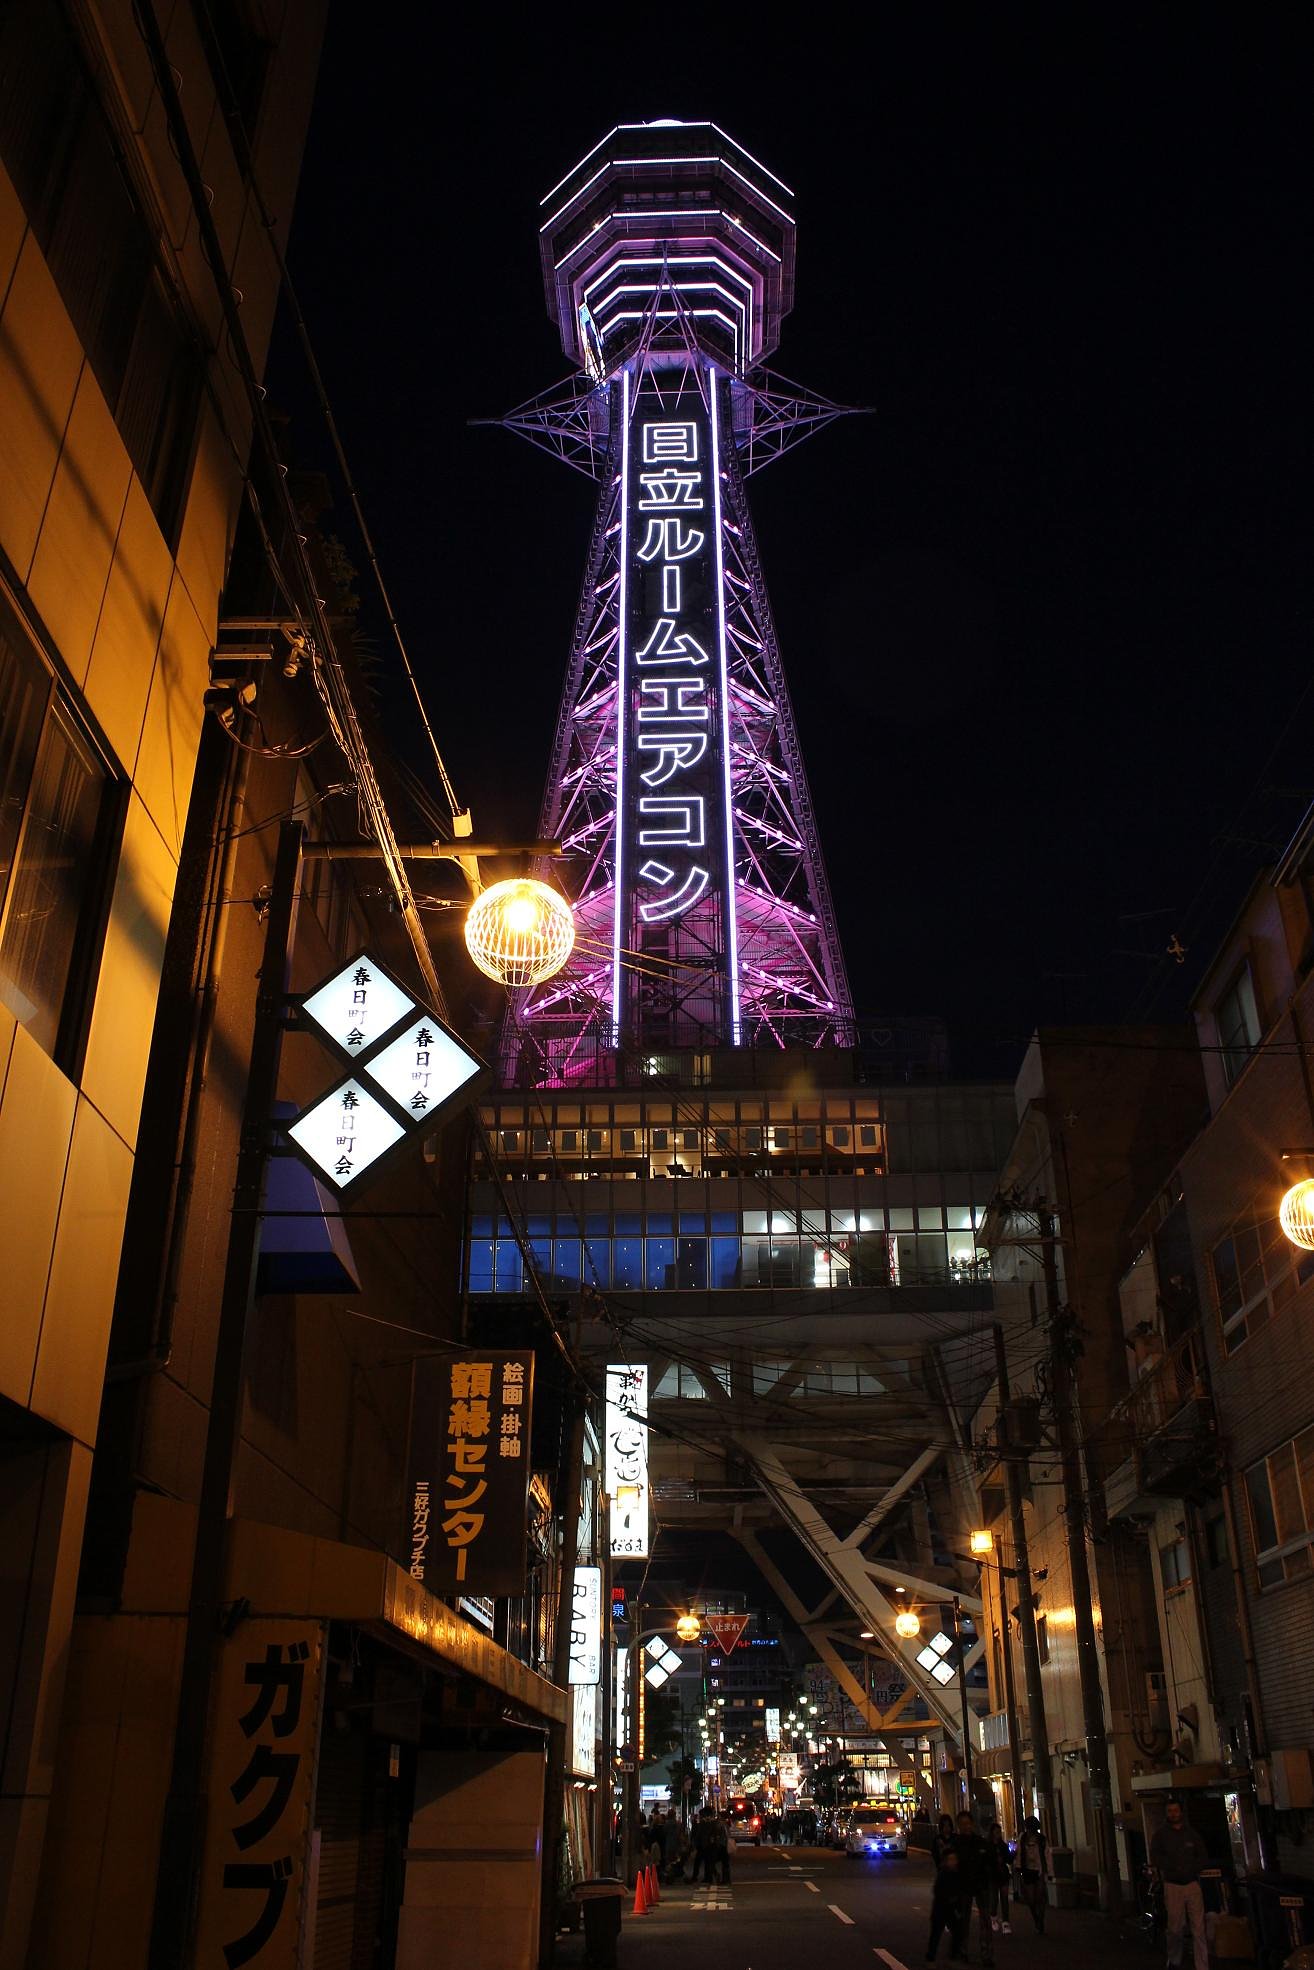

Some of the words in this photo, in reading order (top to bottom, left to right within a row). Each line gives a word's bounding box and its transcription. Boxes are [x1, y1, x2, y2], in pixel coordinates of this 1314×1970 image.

[636, 421, 709, 922] 日立ルームエアコン
[346, 966, 372, 1046] 春日町会
[409, 1027, 435, 1110] 春日町会
[334, 1090, 360, 1175] 春日町会
[441, 1362, 493, 1581] 額縁センター
[409, 1480, 431, 1580] 三好ガクブチ店
[569, 1583, 587, 1668] BABY
[715, 1621, 740, 1632] 止まれ
